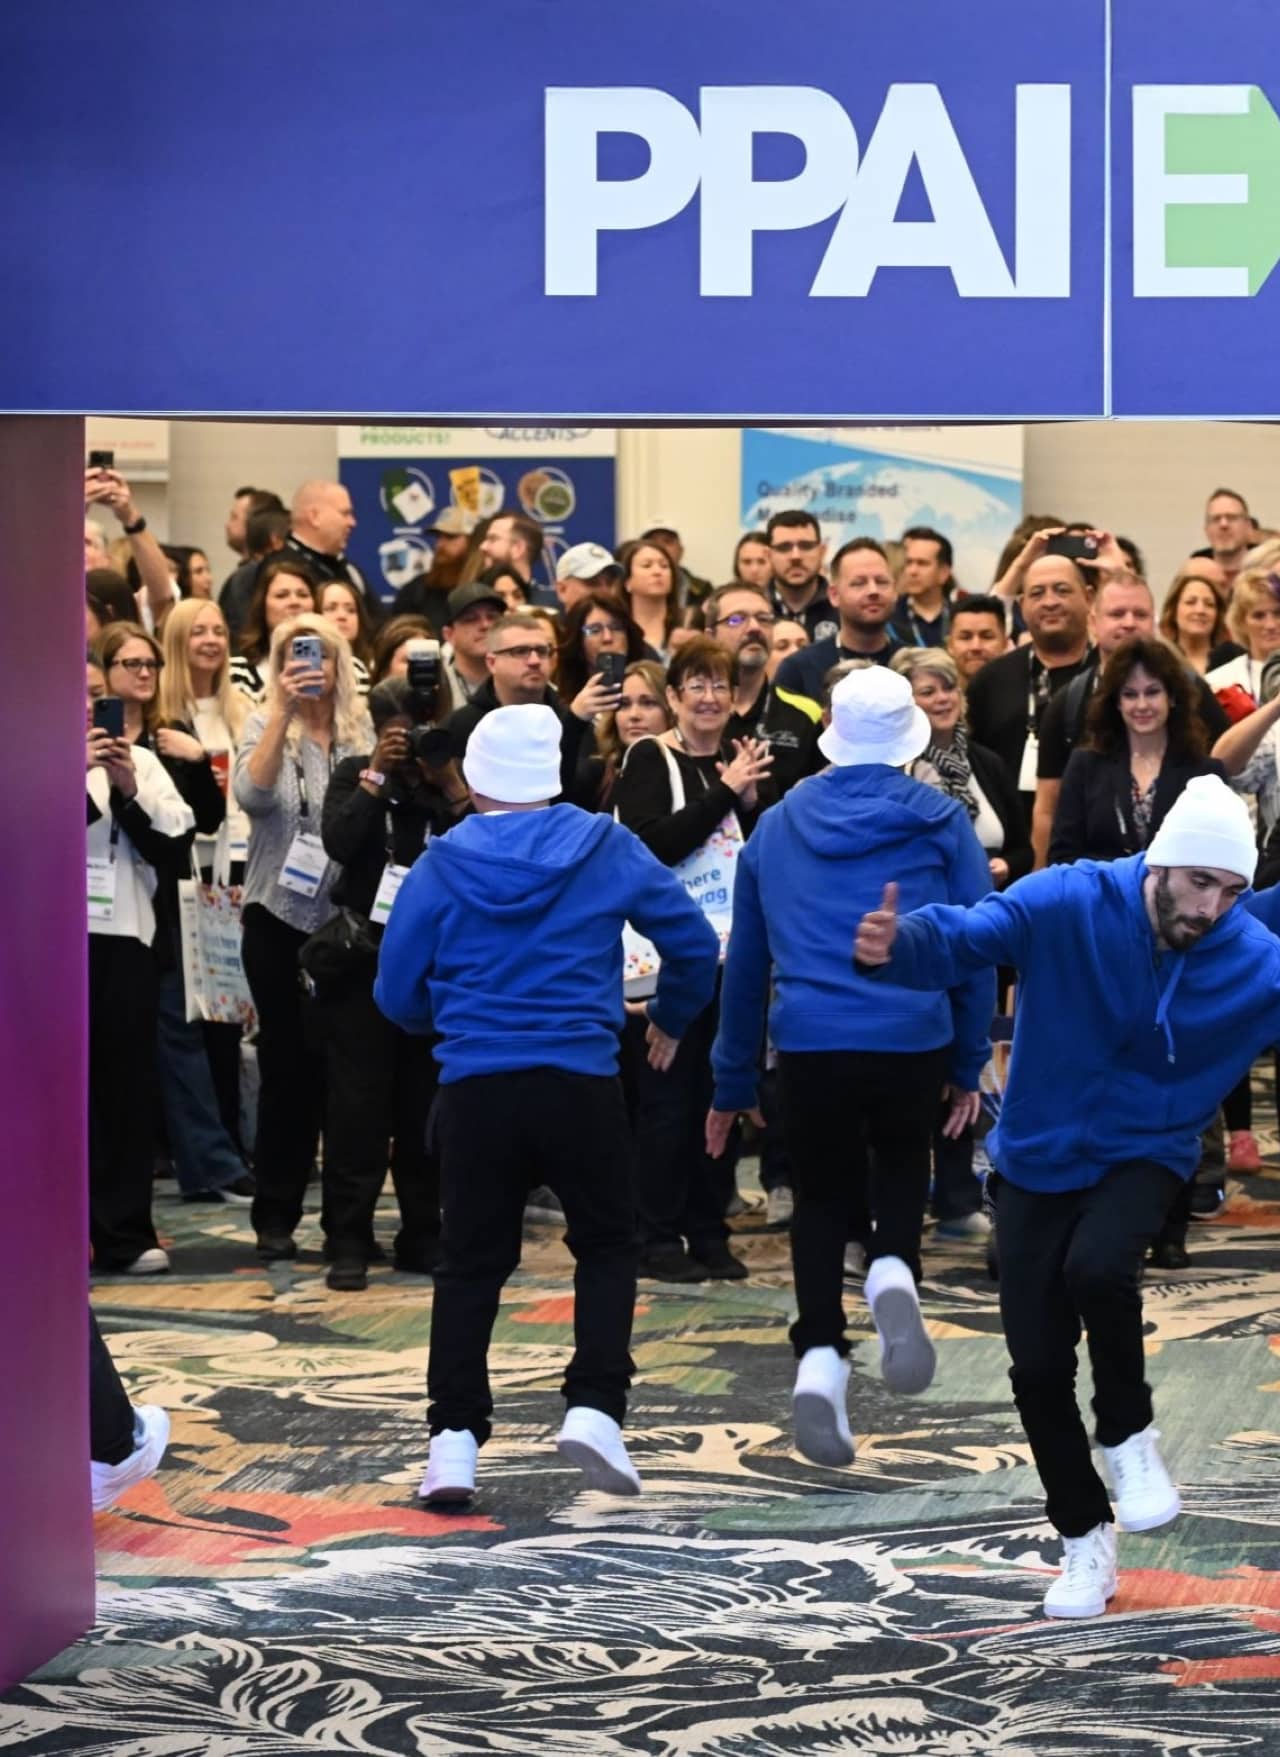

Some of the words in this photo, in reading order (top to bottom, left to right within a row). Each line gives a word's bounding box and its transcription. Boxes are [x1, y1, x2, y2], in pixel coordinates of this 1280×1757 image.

[544, 83, 1071, 298] PPAI
[757, 480, 817, 501] Quality
[825, 481, 898, 498] Branded
